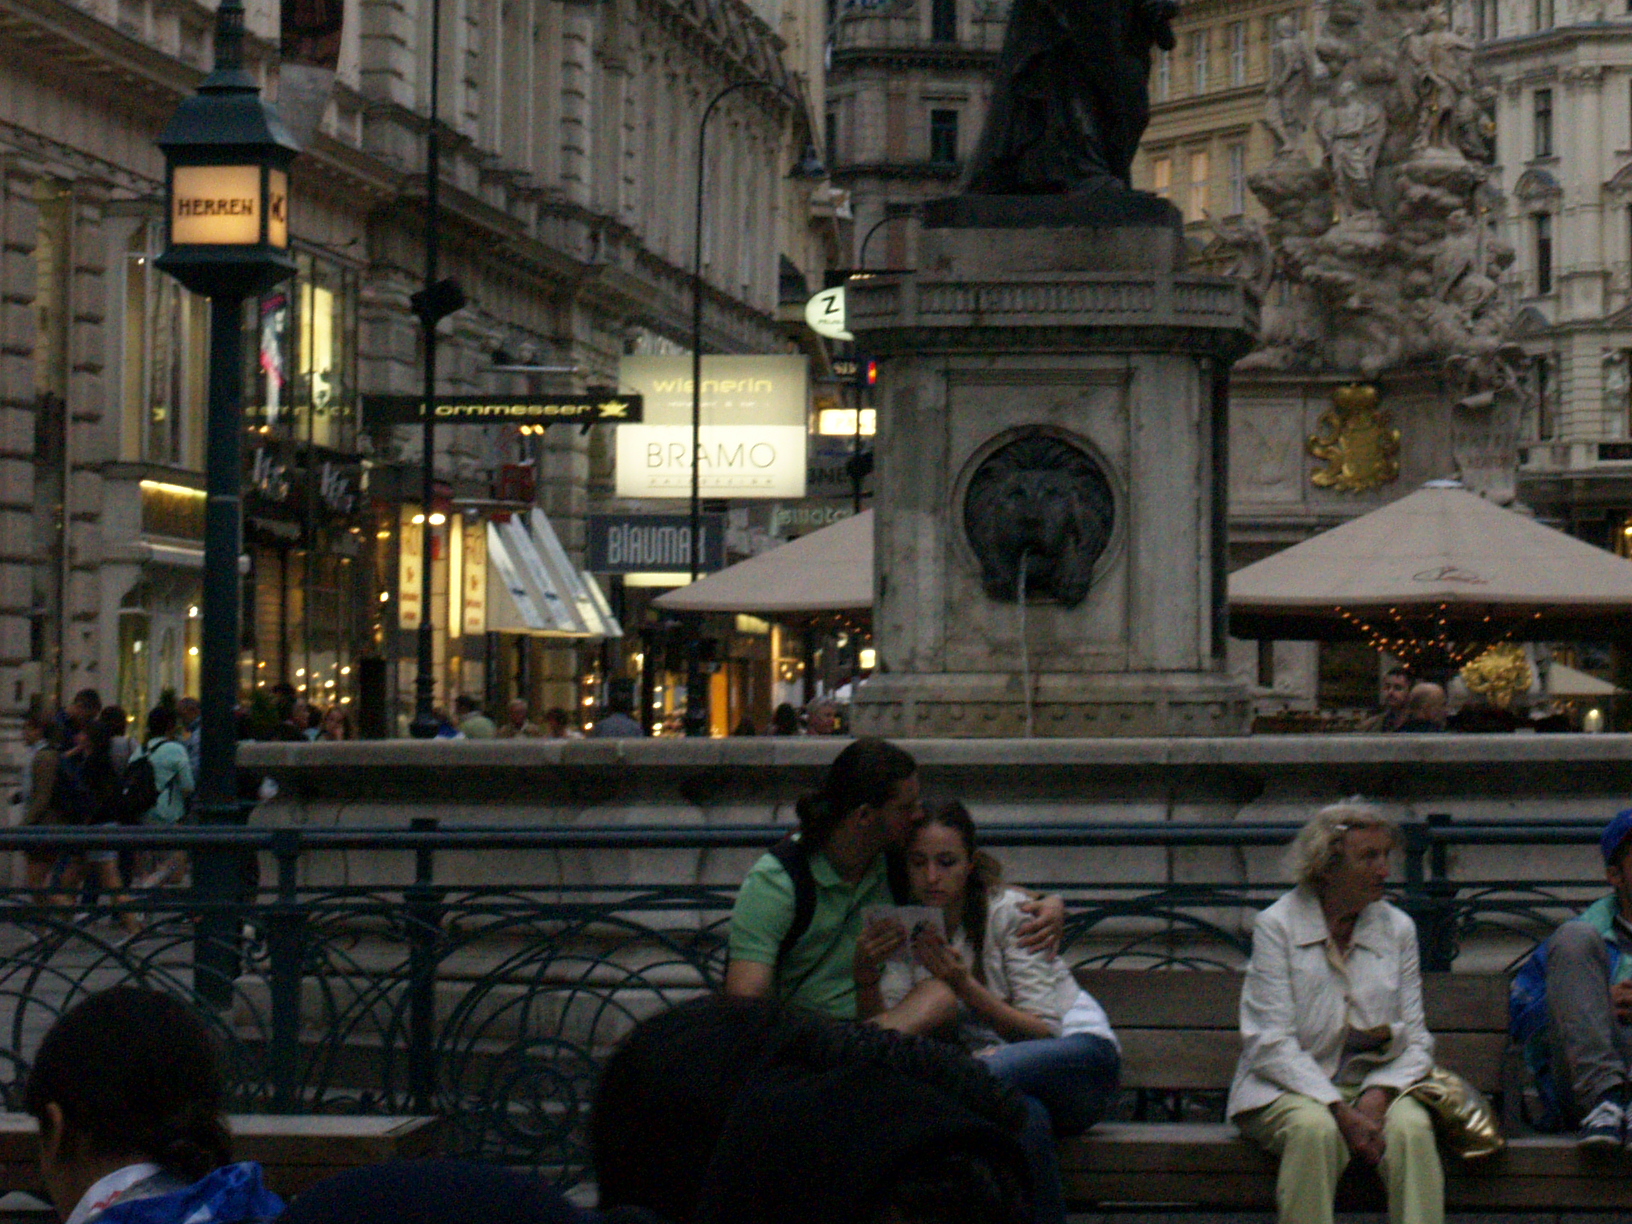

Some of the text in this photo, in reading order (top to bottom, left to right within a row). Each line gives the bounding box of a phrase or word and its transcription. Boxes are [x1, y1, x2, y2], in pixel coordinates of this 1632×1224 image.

[178, 198, 253, 215] HERREN
[419, 402, 591, 416] ornmesser
[647, 442, 776, 468] BRAMO
